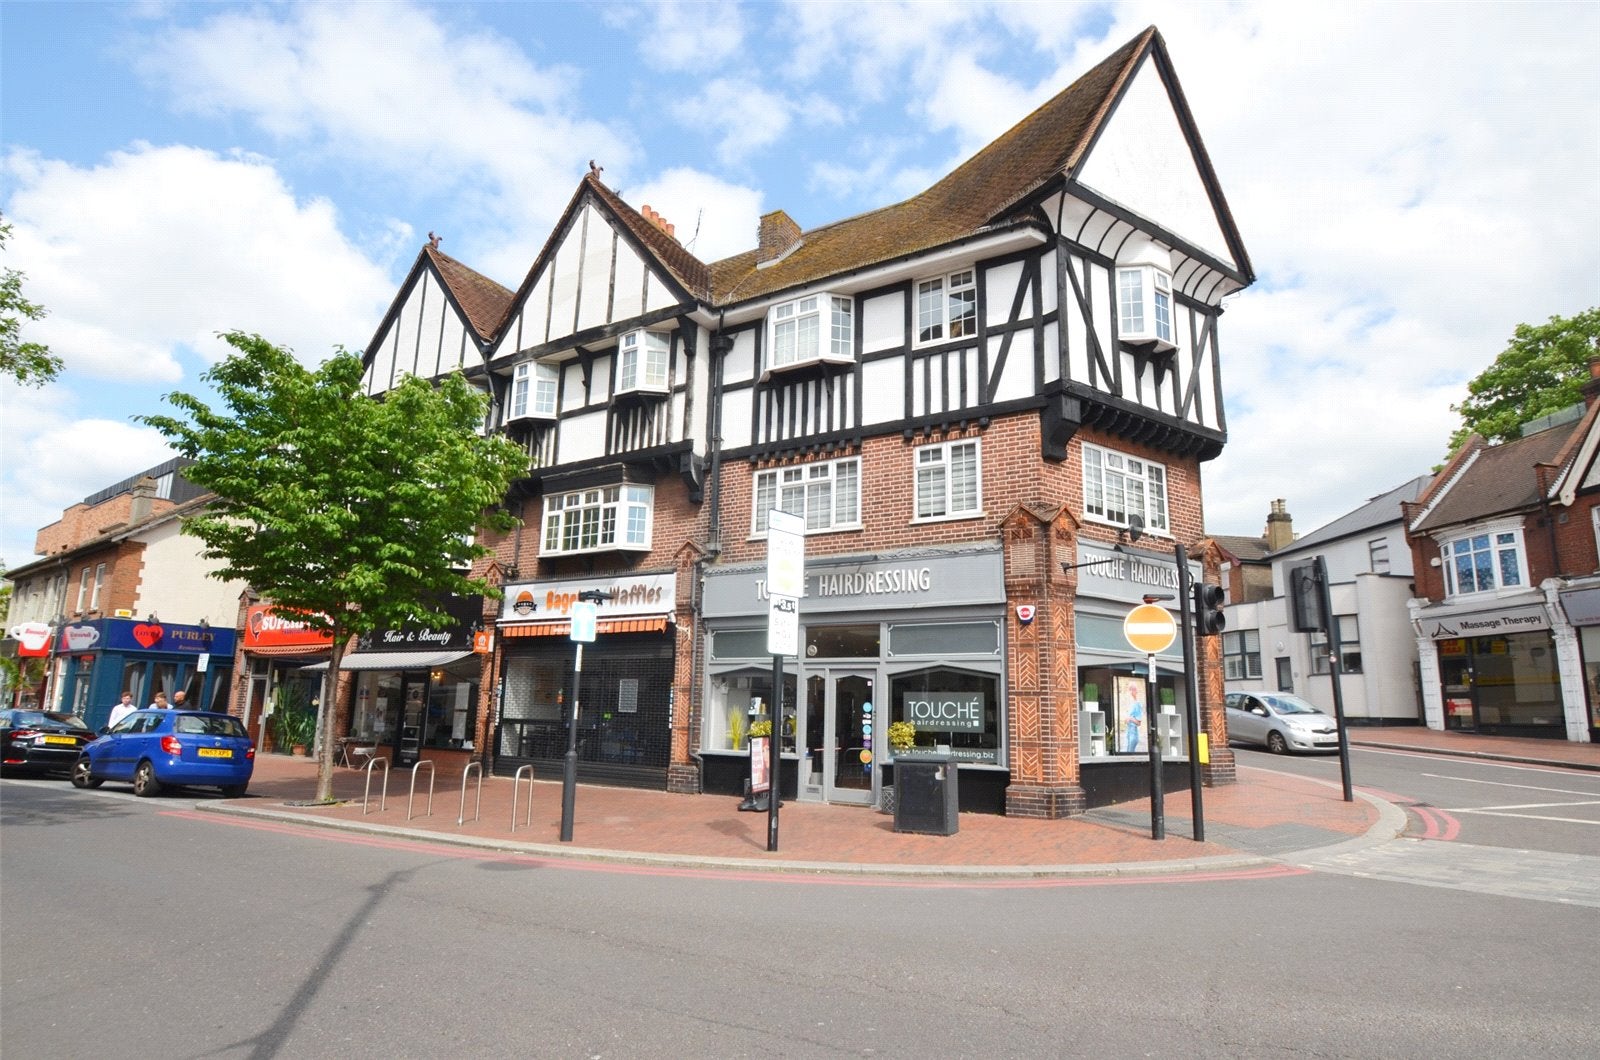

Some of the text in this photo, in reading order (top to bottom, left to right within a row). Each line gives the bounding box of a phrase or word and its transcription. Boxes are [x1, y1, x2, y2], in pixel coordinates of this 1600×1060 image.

[818, 567, 931, 597] HAIRDRESSING
[609, 584, 663, 606] Waffles
[1460, 614, 1542, 630] Massage Therapy
[171, 630, 216, 642] PURLEY
[383, 628, 452, 646] Hair & Beauty
[908, 696, 980, 719] TOUCHÉ
[910, 719, 972, 728] hairdressing
